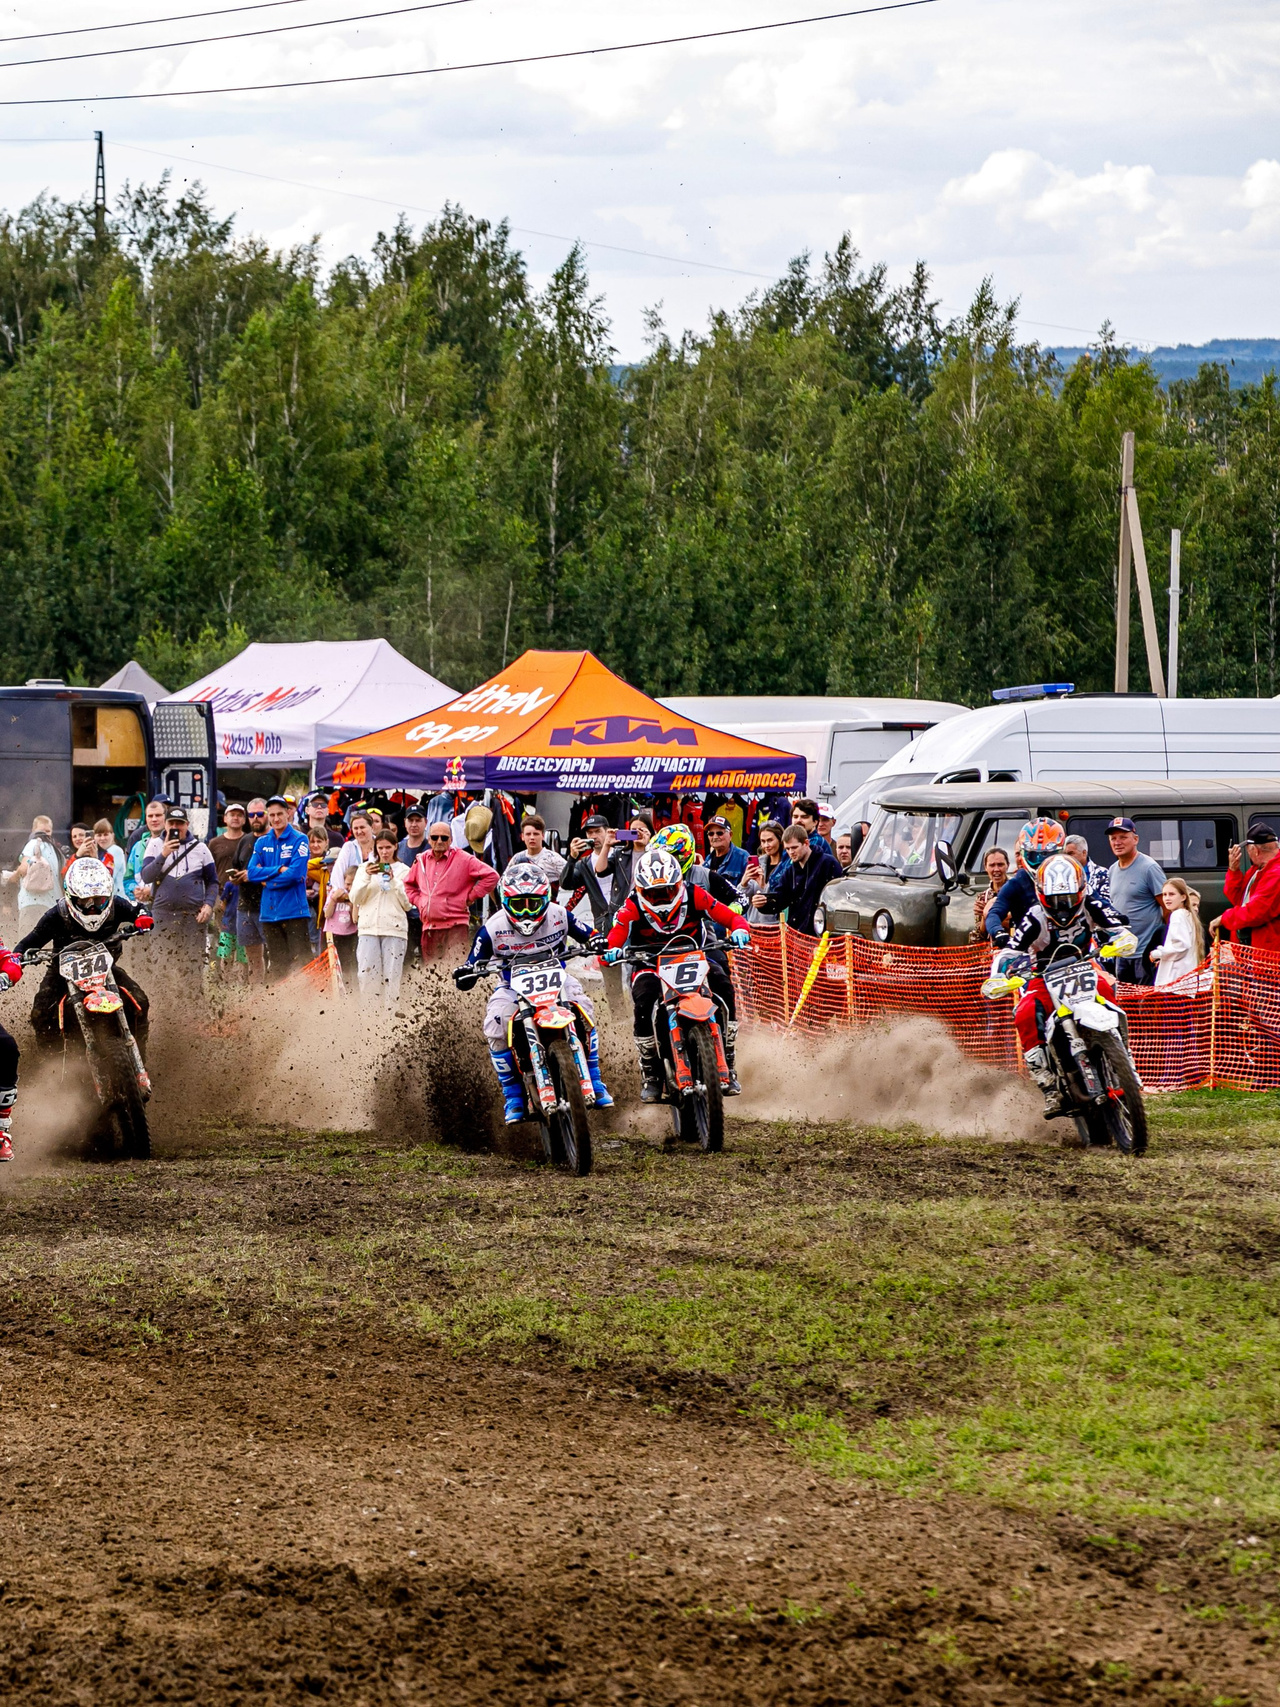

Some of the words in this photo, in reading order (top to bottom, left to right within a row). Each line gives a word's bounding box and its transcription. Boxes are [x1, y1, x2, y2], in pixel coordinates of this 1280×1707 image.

[222, 733, 254, 756] Uktus
[255, 731, 282, 755] Moto
[549, 715, 699, 747] KTM
[332, 757, 367, 786] KTM
[496, 756, 595, 772] АКСЕССУАРЫ
[631, 757, 707, 773] ЗАПЧАСТИ
[556, 774, 654, 789] ЭКИПИРОВКА
[670, 774, 702, 791] для
[71, 954, 108, 980] 134
[675, 962, 699, 985] 6
[521, 972, 562, 995] 334
[1052, 972, 1096, 1000] 776
